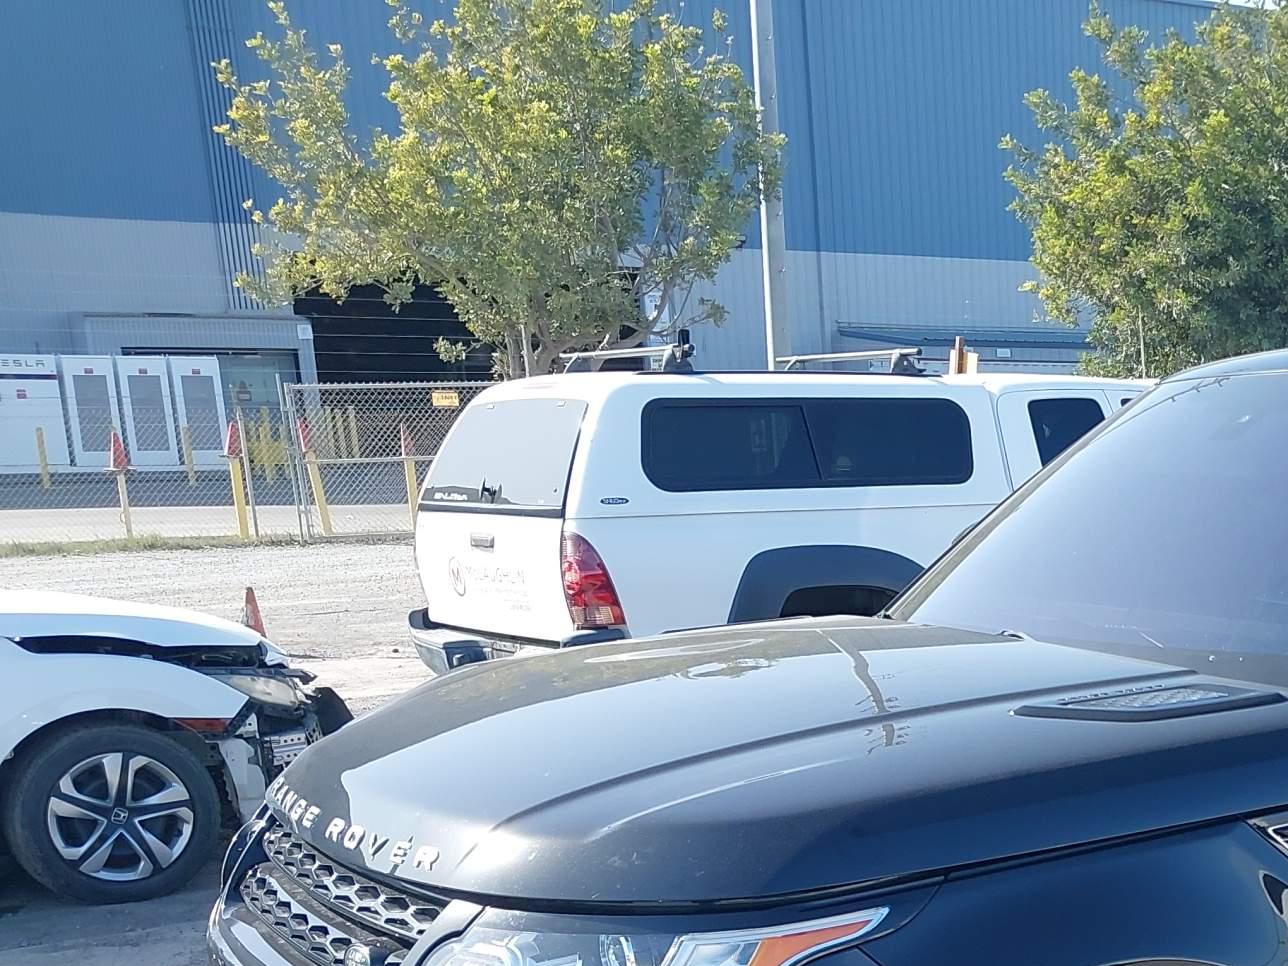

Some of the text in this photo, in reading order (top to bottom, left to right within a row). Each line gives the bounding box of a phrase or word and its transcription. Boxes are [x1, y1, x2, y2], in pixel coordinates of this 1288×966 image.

[0, 359, 45, 368] ESLA
[273, 777, 440, 872] RANGE ROVER
